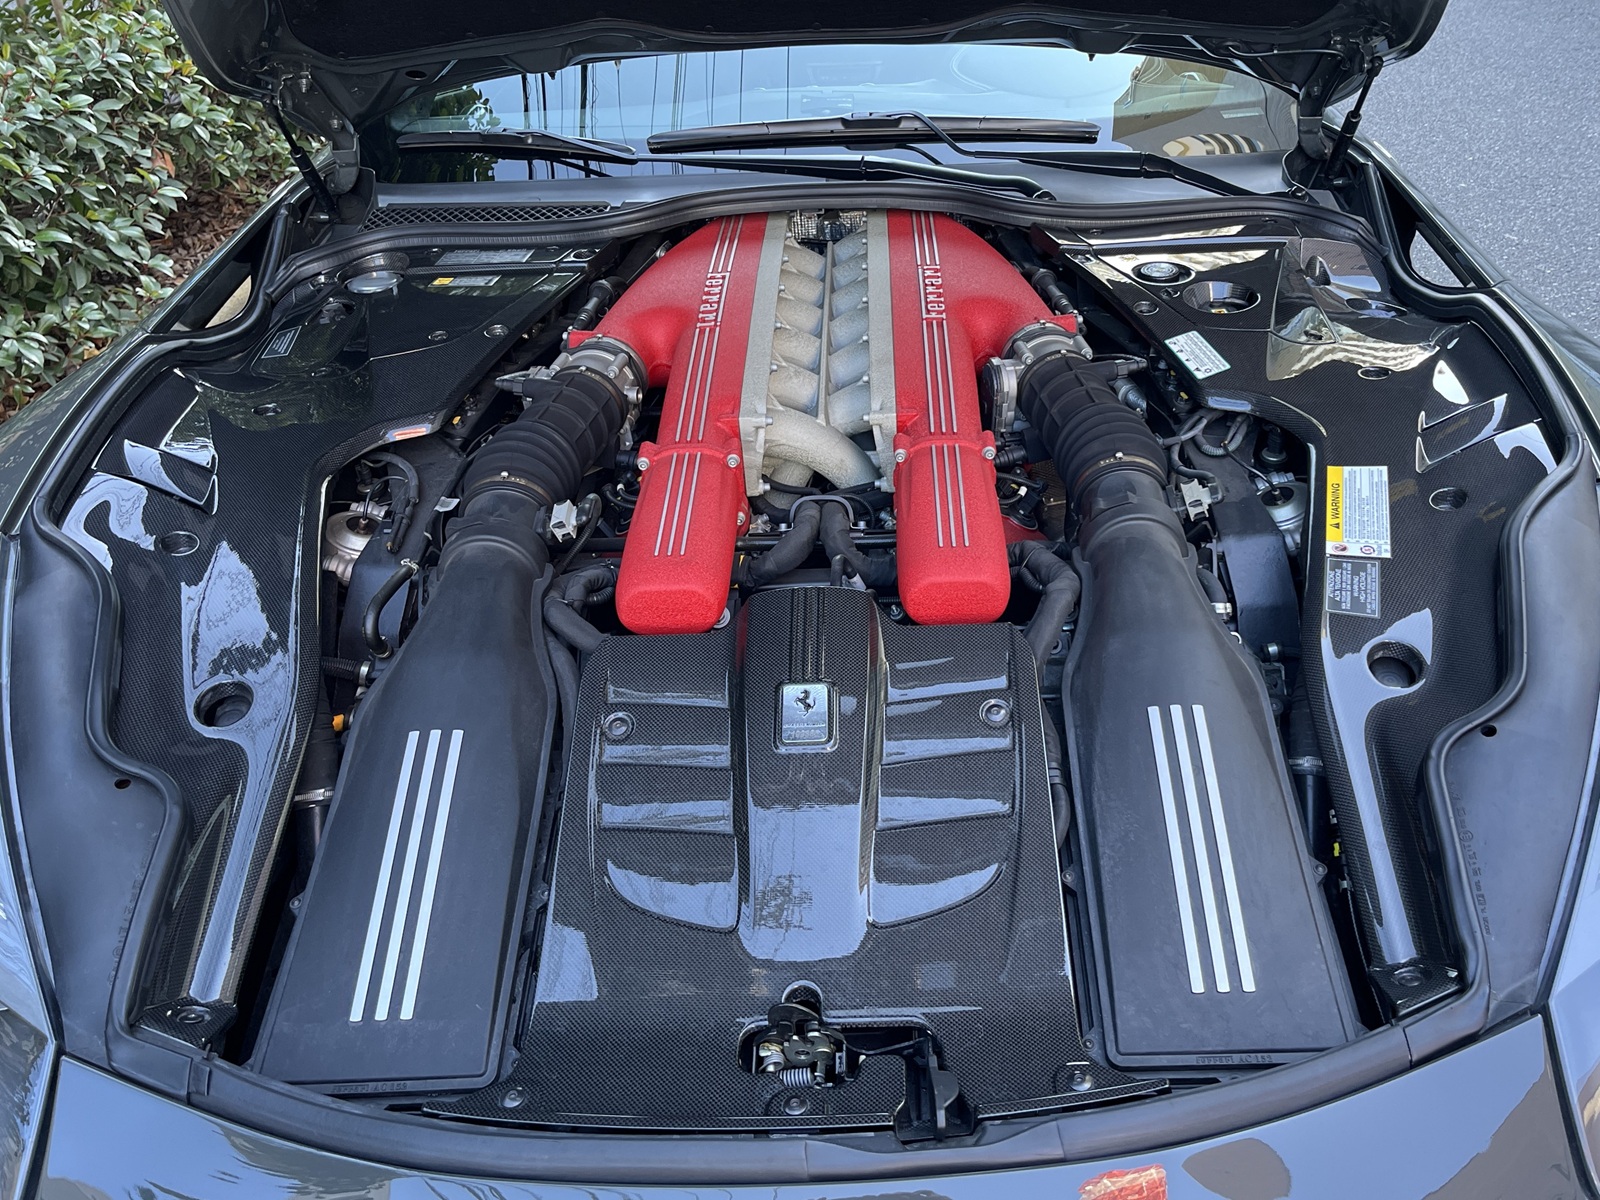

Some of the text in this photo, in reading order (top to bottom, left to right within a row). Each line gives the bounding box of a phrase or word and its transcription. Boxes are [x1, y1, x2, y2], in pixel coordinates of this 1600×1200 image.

[696, 272, 731, 328] Ferrari
[917, 265, 946, 320] Ferrari
[1331, 482, 1341, 520] WARNING
